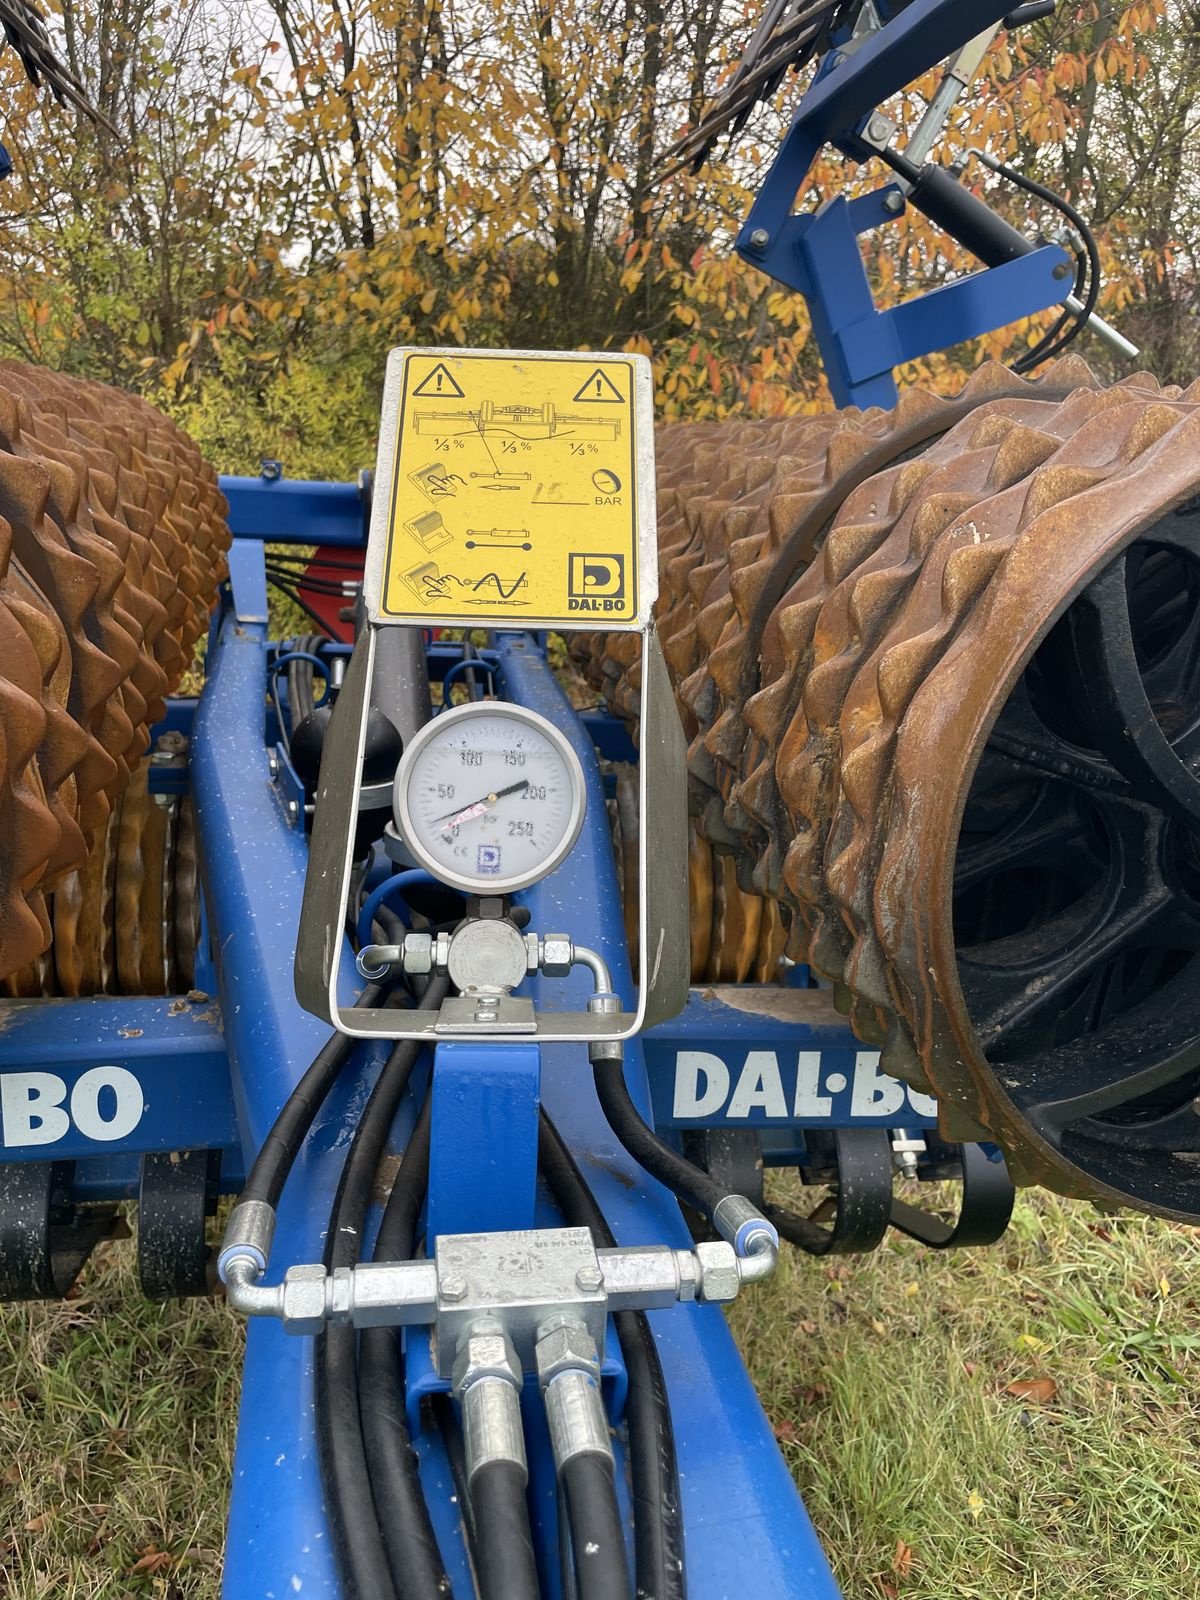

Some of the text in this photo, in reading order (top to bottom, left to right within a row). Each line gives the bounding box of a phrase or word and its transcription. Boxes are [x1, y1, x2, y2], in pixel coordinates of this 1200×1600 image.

[595, 496, 622, 505] BAR
[459, 752, 483, 766] 100
[504, 751, 526, 766] 150
[438, 784, 456, 799] 50
[520, 786, 546, 800] 200
[508, 821, 534, 837] 250
[0, 1066, 144, 1148] BO
